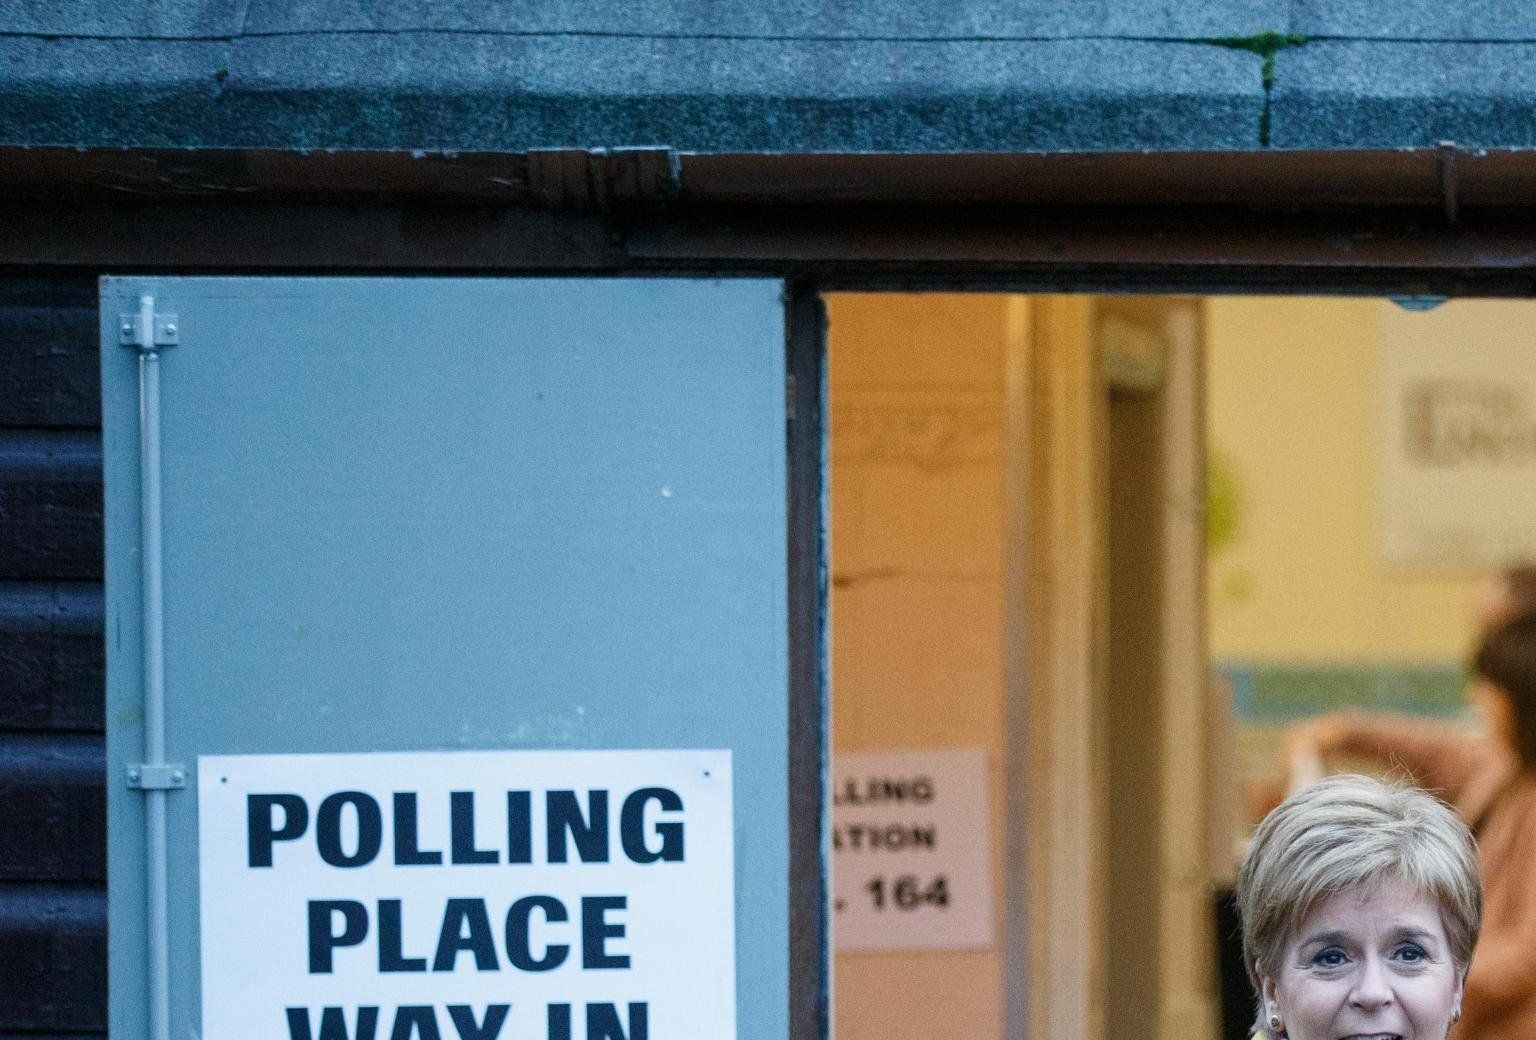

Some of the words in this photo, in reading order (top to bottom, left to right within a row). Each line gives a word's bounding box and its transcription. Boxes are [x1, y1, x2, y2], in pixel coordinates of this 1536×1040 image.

[246, 787, 686, 869] POLLING
[864, 875, 950, 912] 164
[307, 895, 631, 974] PLACE
